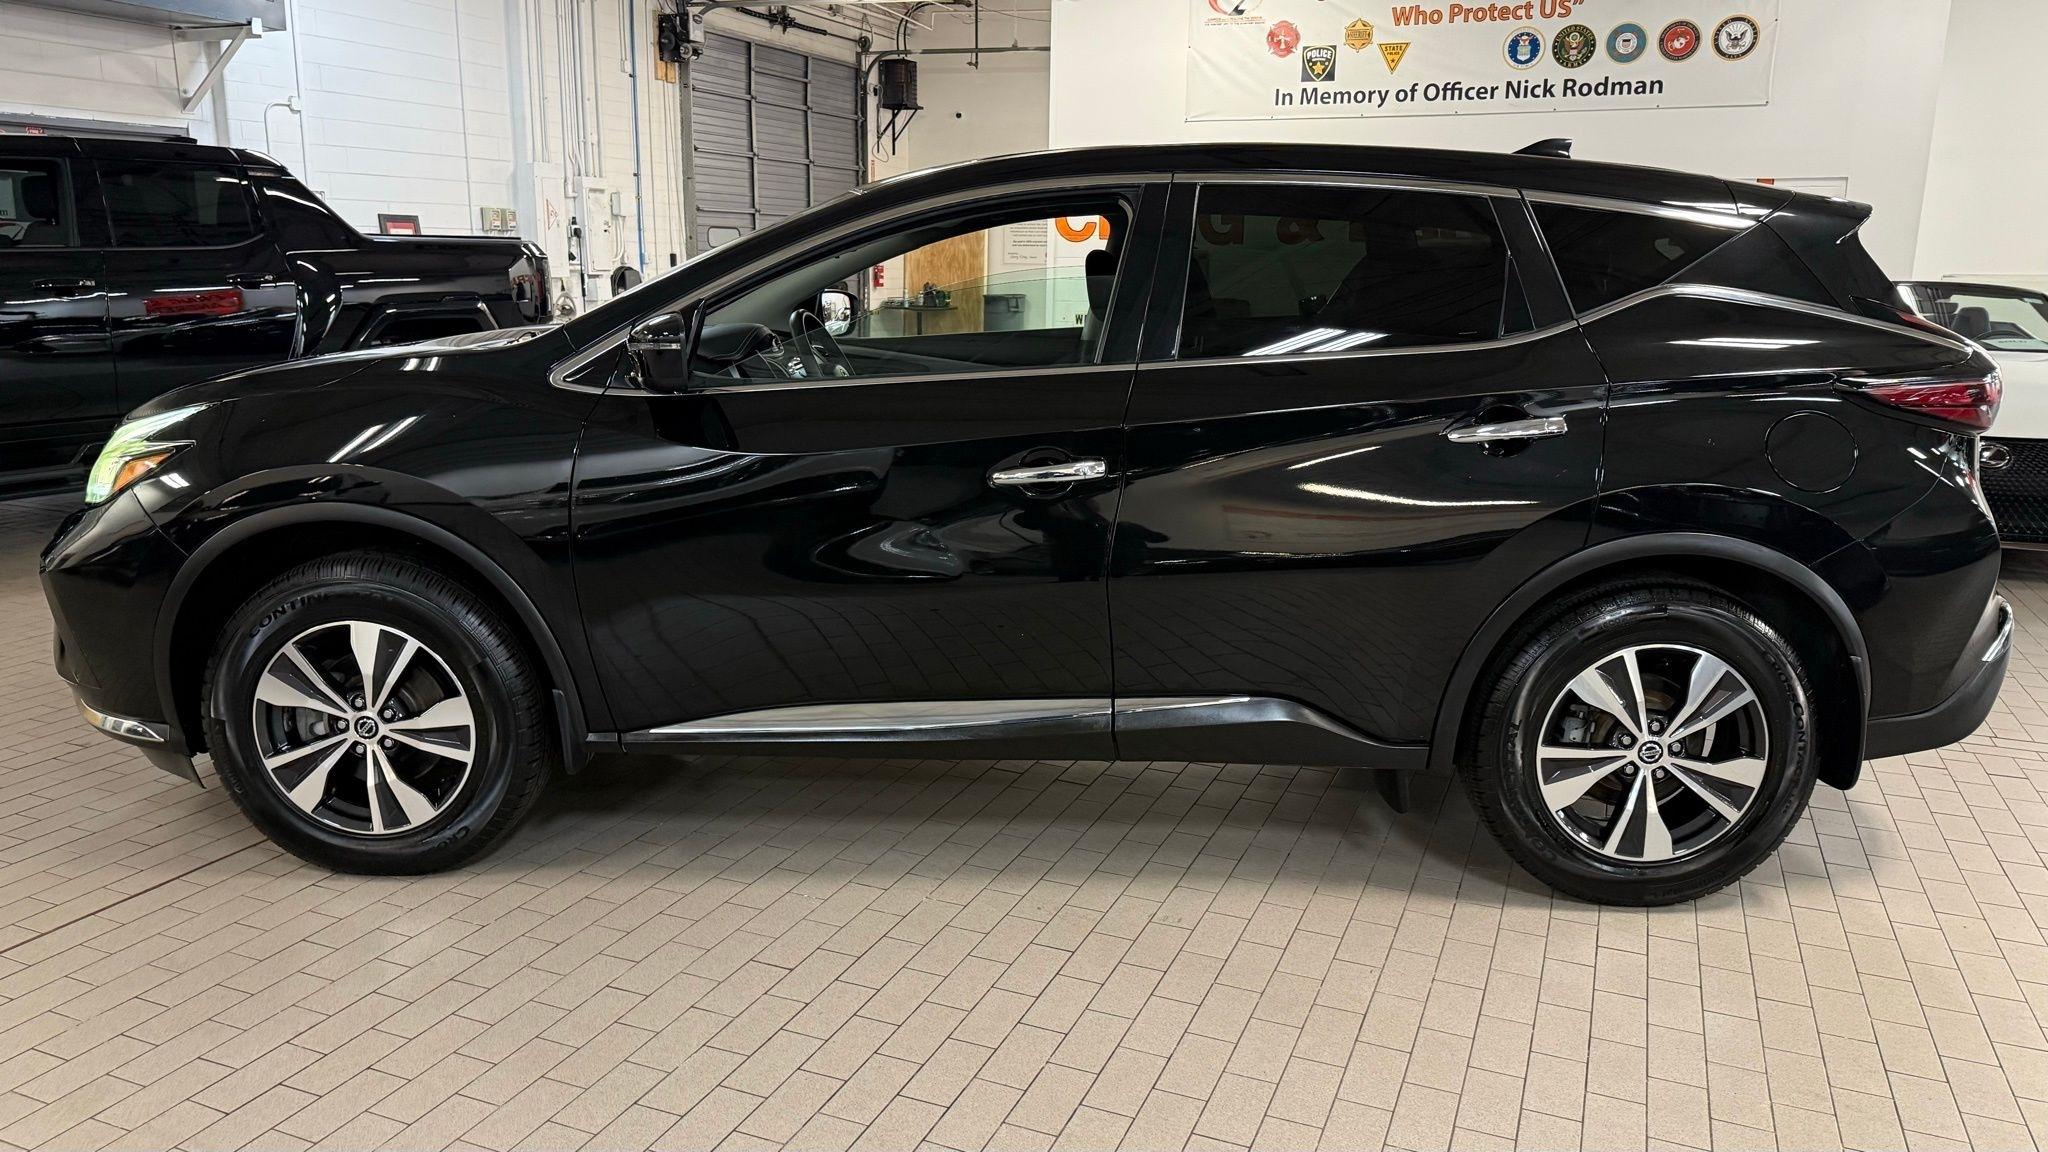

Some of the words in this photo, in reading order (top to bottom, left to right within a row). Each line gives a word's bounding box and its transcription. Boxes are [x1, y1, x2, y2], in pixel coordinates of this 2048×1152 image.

[1392, 5, 1443, 26] Who
[1449, 2, 1533, 23] Protect
[1306, 48, 1332, 60] POLICE
[1276, 89, 1292, 105] In
[1301, 87, 1389, 108] Memory
[1396, 83, 1418, 102] of
[1424, 82, 1498, 101] Officer
[1506, 79, 1556, 98] Nick
[1563, 76, 1664, 95] Rodman
